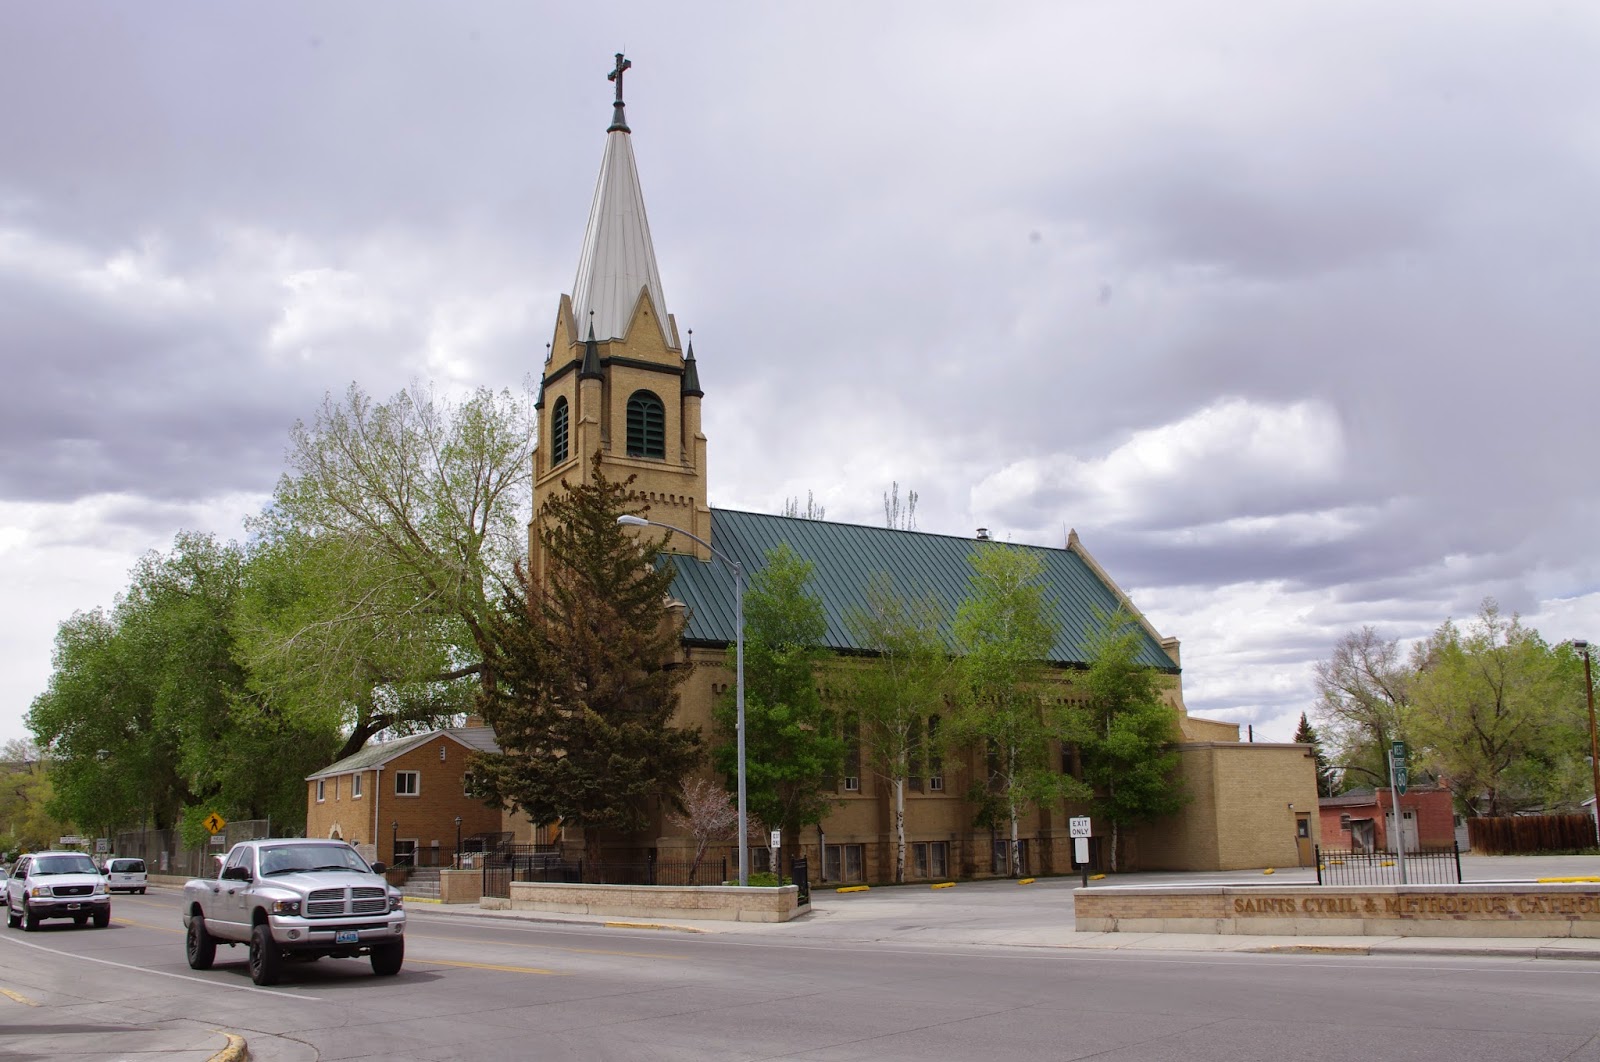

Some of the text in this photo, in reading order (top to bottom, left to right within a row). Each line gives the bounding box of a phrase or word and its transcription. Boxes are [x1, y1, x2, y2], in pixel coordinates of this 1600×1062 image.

[1393, 744, 1404, 756] WEST
[1397, 772, 1406, 787] 80
[1071, 828, 1089, 836] ONLY
[1233, 897, 1297, 914] SAINTS
[1302, 897, 1358, 914] CYRIL
[1363, 897, 1377, 914] &
[1385, 897, 1509, 914] METHODIUS
